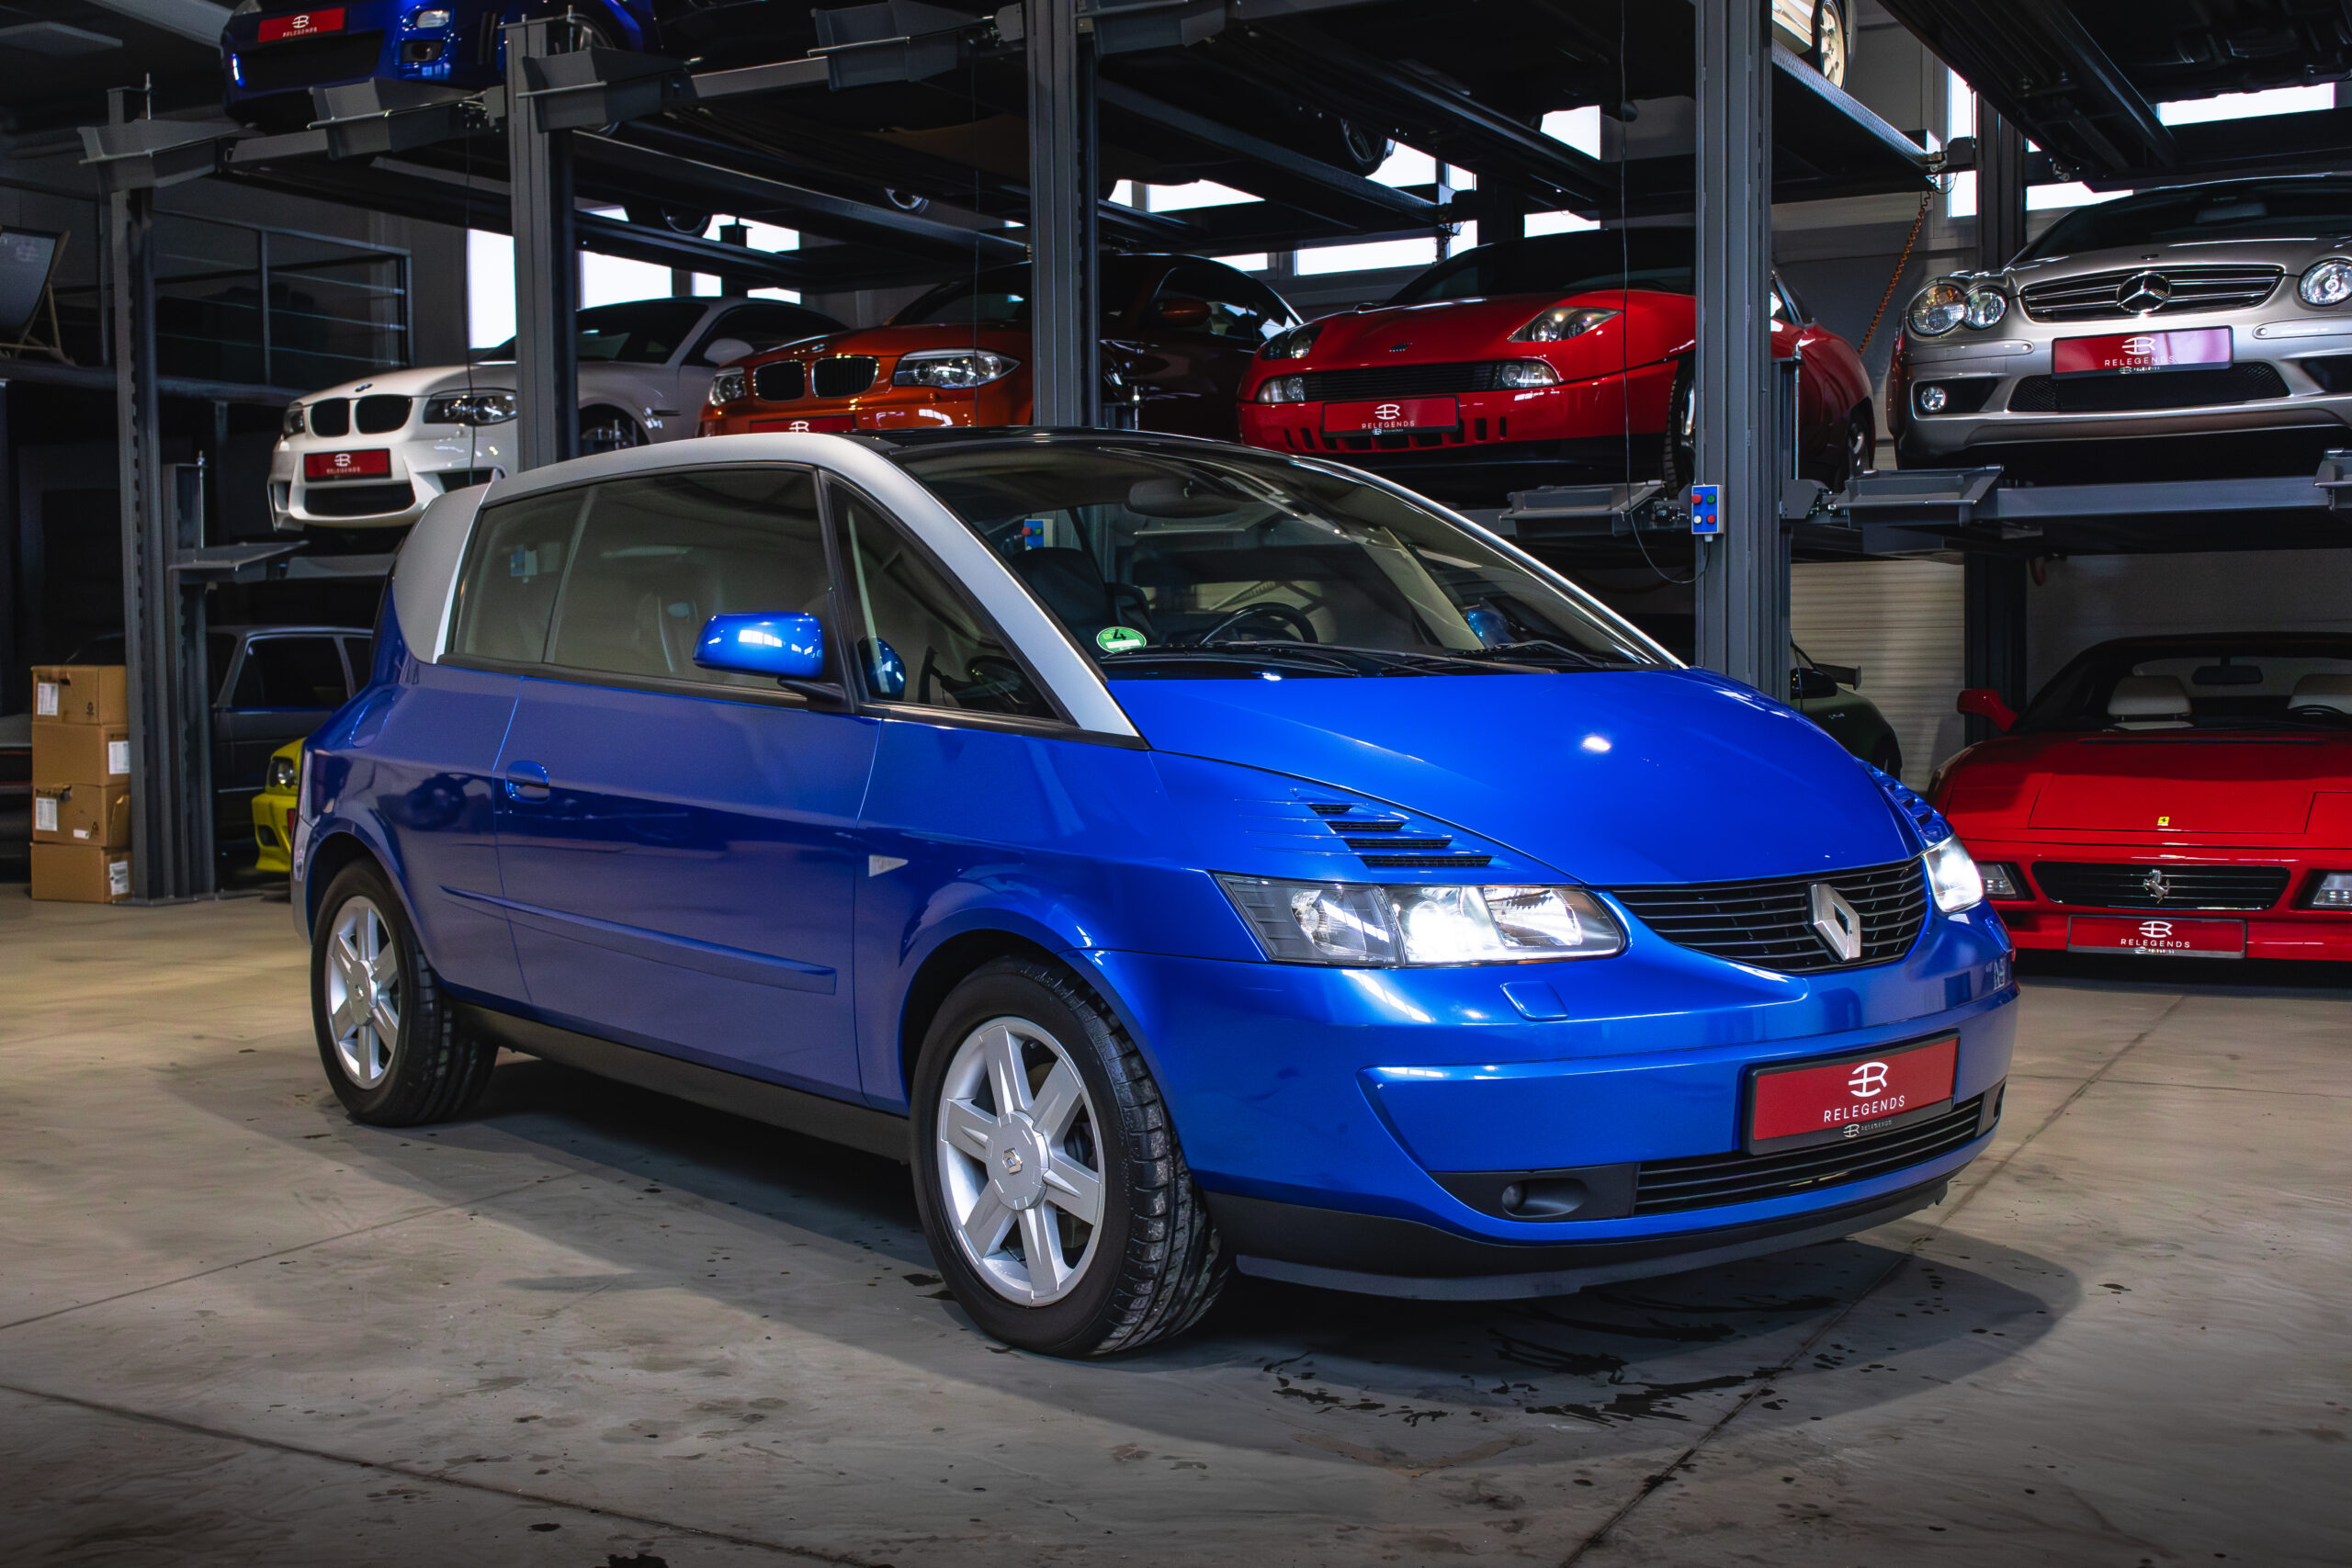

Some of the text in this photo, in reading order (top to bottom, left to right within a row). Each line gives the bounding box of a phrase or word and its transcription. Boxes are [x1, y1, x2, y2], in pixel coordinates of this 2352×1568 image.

[2104, 355, 2176, 367] RELEGENDS
[1362, 420, 1416, 430] RELEGENDS
[2120, 938, 2191, 949] RELEGENDS
[1823, 1095, 1905, 1123] RELEGENDS
